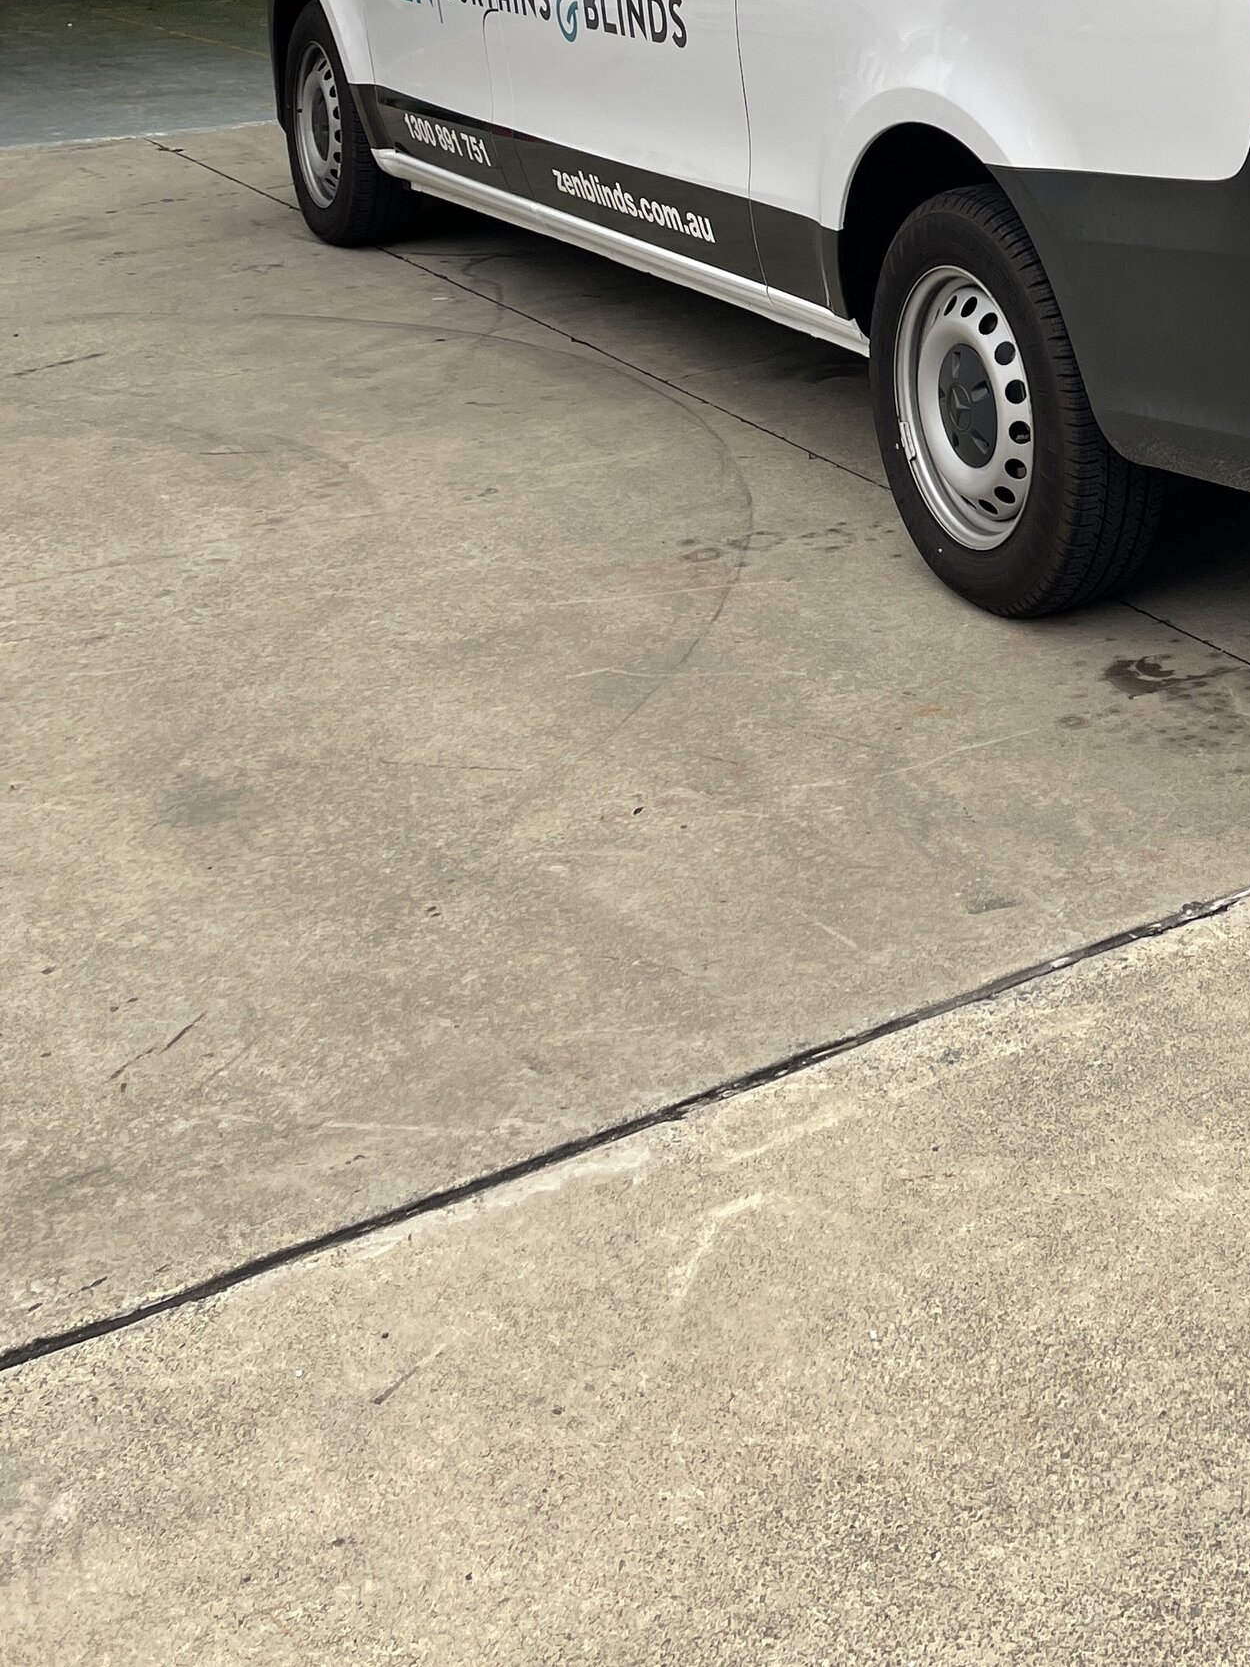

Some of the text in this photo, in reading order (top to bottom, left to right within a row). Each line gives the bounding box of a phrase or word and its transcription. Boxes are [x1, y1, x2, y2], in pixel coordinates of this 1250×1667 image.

[404, 114, 491, 167] 1300 891 751
[552, 168, 716, 244] zenblinds.com.au
